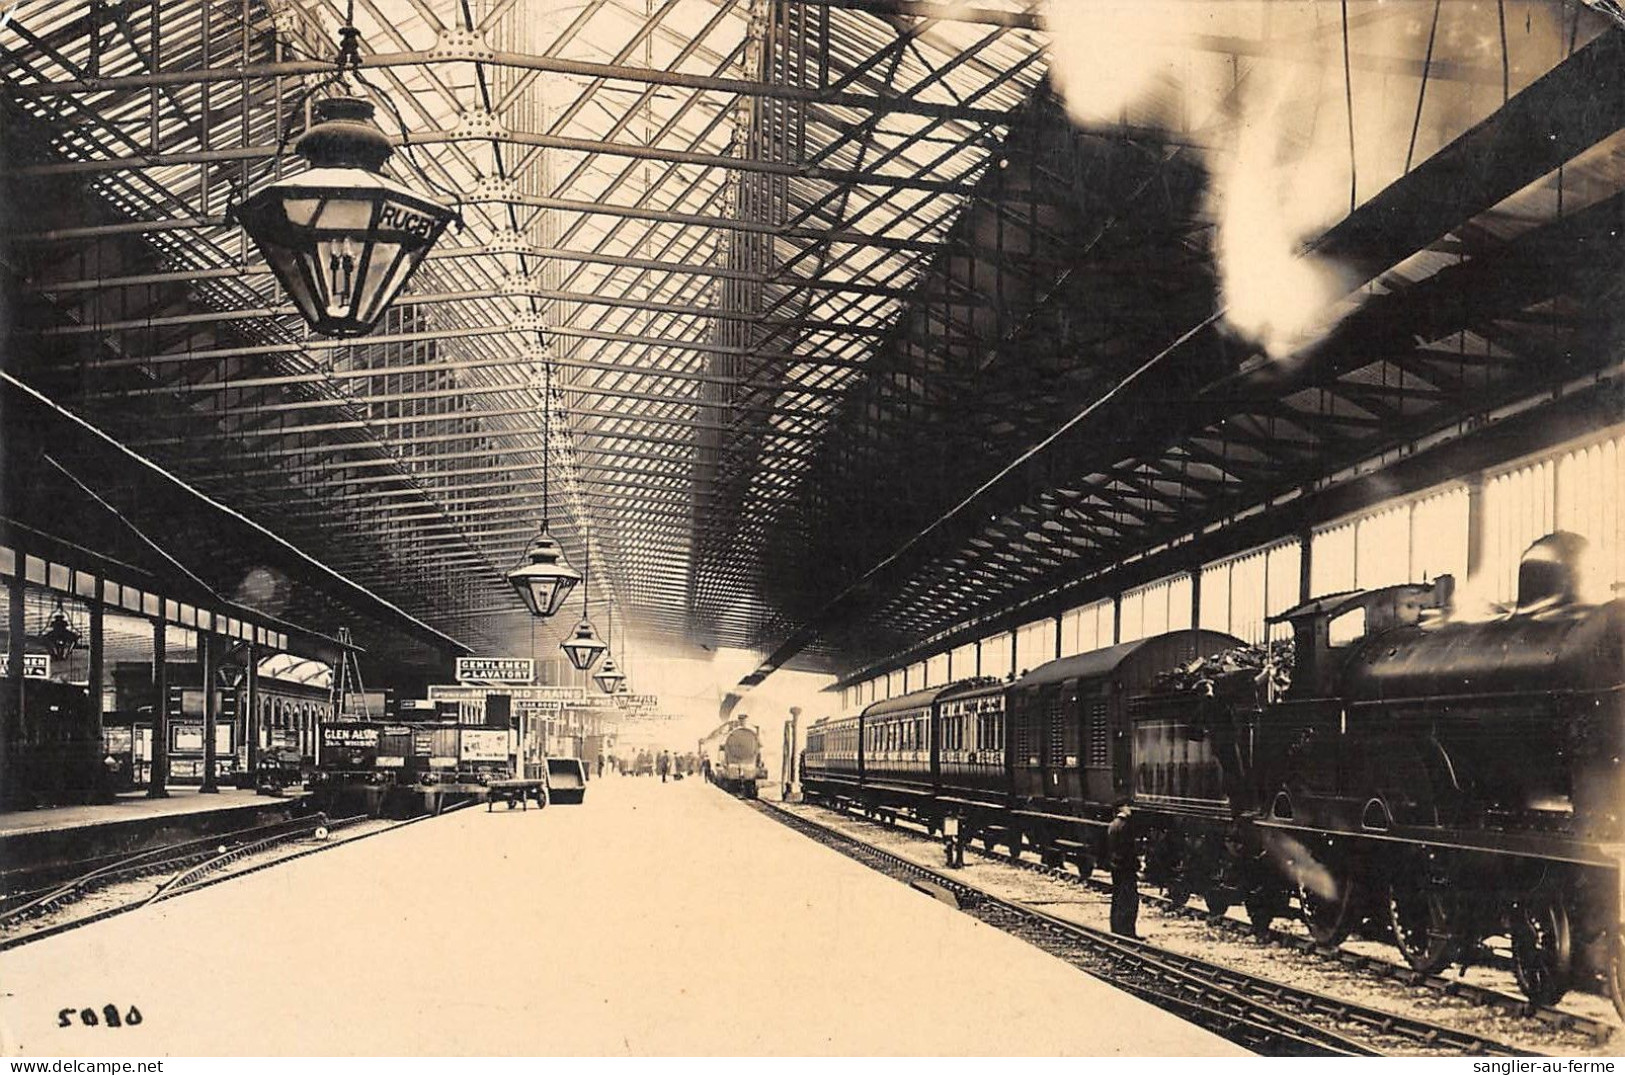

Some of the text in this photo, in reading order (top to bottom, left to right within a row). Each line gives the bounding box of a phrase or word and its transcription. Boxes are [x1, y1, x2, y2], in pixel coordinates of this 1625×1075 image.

[461, 661, 529, 669] GENTLEMEN
[472, 670, 529, 678] LAVATORY
[535, 689, 582, 699] TRAINS
[324, 729, 350, 739] GLEN
